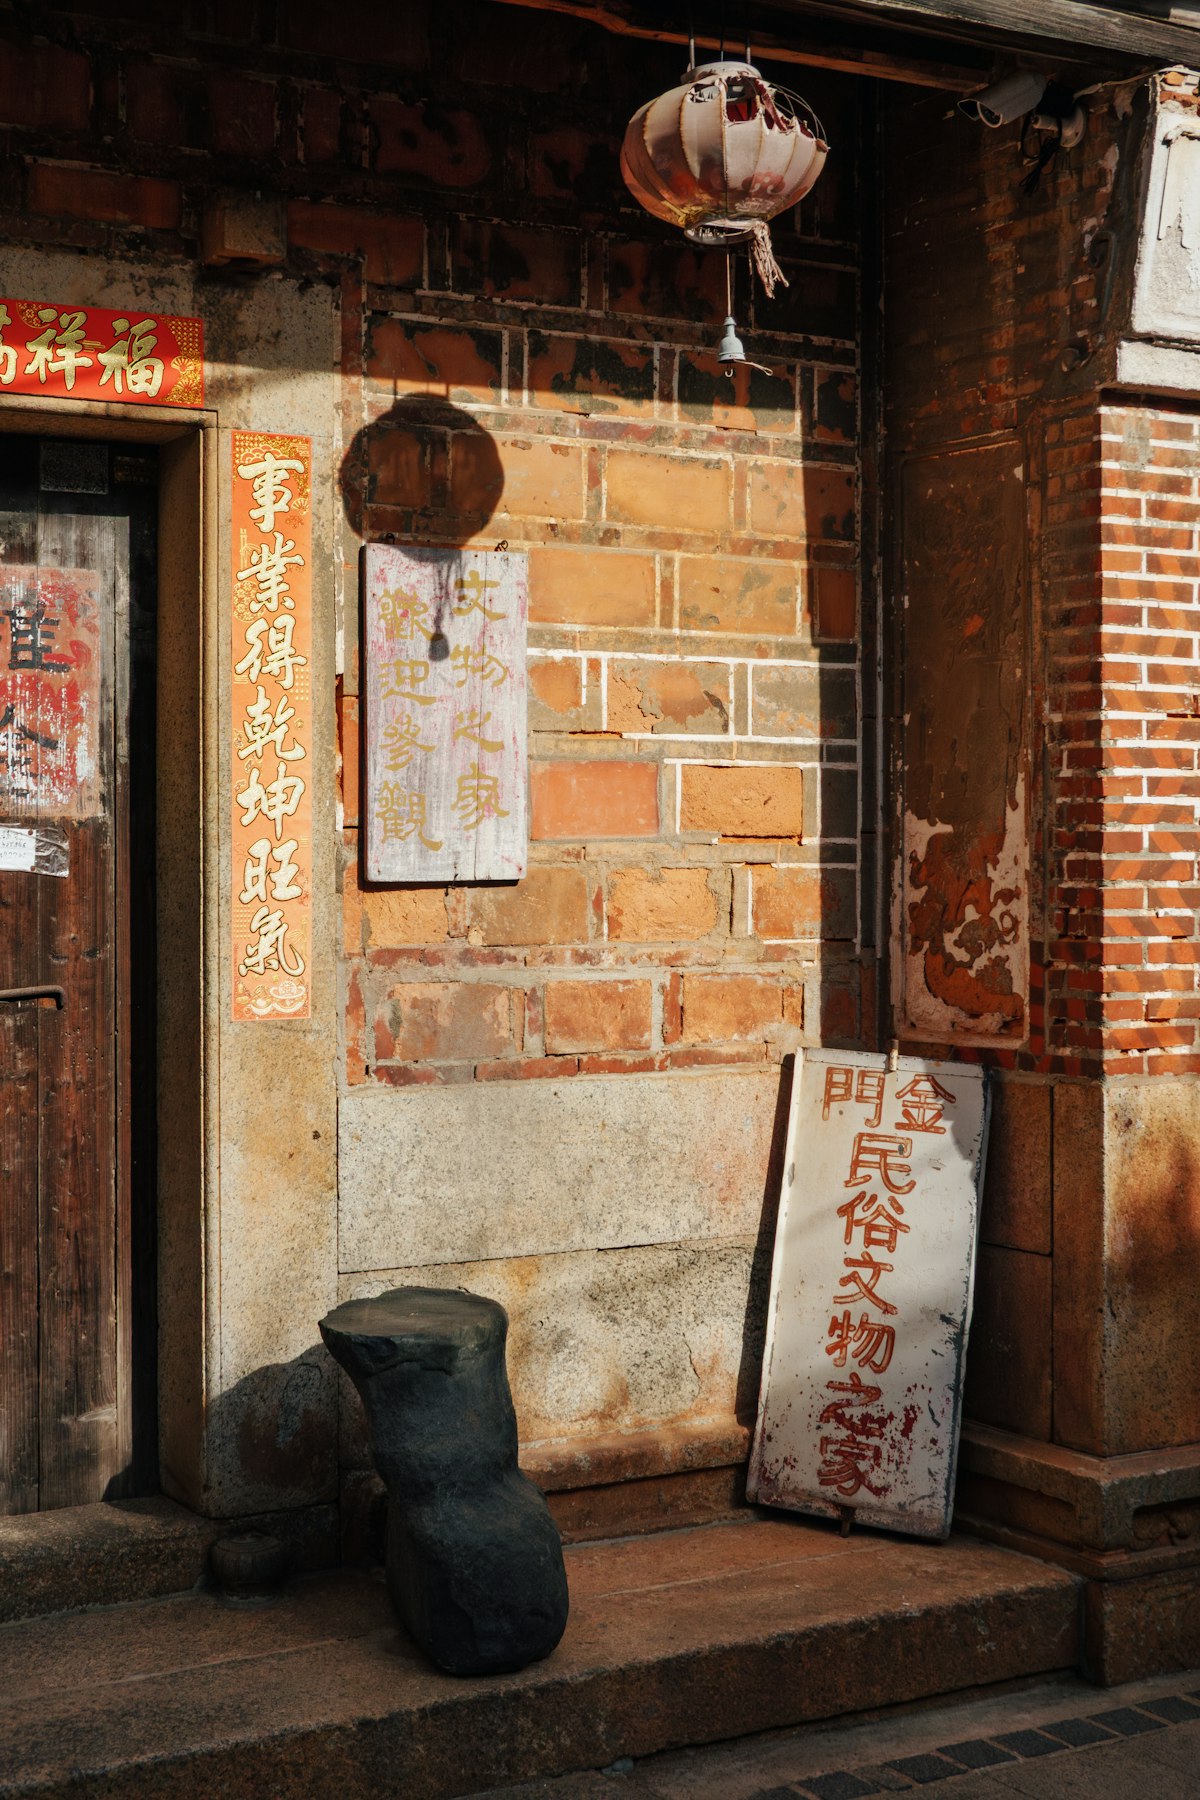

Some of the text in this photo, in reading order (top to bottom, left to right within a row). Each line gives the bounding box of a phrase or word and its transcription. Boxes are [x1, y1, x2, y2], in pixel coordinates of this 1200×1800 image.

[235, 452, 307, 978] 事業得乾坤旺氣
[451, 570, 511, 832] 文物之家
